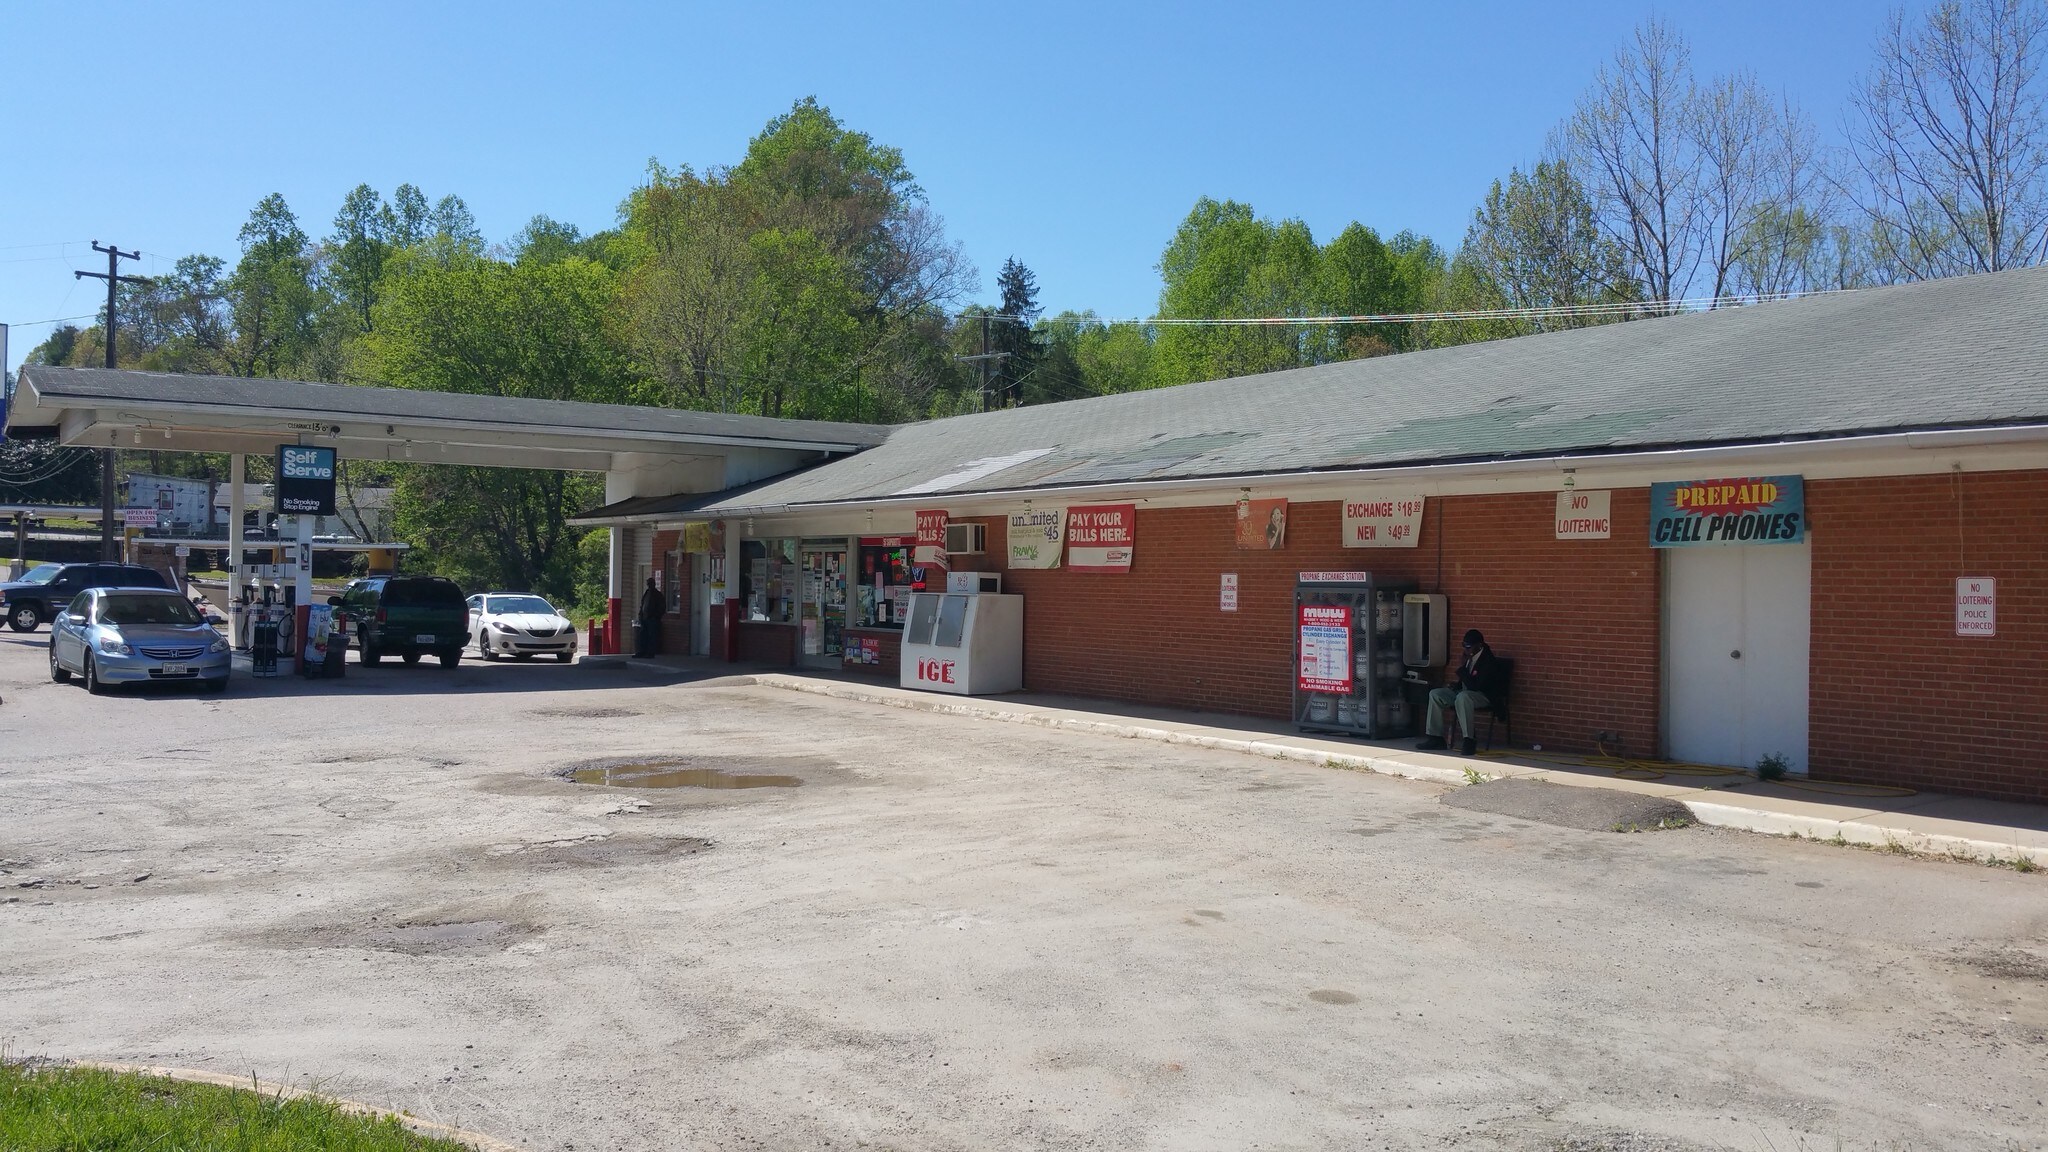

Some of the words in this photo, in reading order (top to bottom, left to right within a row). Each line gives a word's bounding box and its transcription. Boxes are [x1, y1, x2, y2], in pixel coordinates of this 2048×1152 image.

[284, 450, 317, 464] Self
[284, 463, 331, 477] Serve
[1676, 483, 1778, 507] PREPAID
[1572, 496, 1588, 509] NO
[1347, 503, 1393, 518] EXCHANGE
[918, 516, 933, 528] PAY
[1070, 513, 1090, 526] PAY
[1093, 512, 1121, 526] YOUR
[1558, 519, 1608, 533] LOITERING
[1044, 526, 1058, 540] $45
[1070, 529, 1097, 542] BILLS
[1100, 528, 1130, 542] HERE.
[1357, 526, 1376, 540] NEW
[1655, 516, 1703, 543] CELL
[1707, 513, 1799, 540] PHONES
[918, 530, 938, 542] BILLS
[1970, 584, 1980, 592] NO
[1959, 596, 1992, 605] LOITERING
[918, 656, 955, 684] ICE
